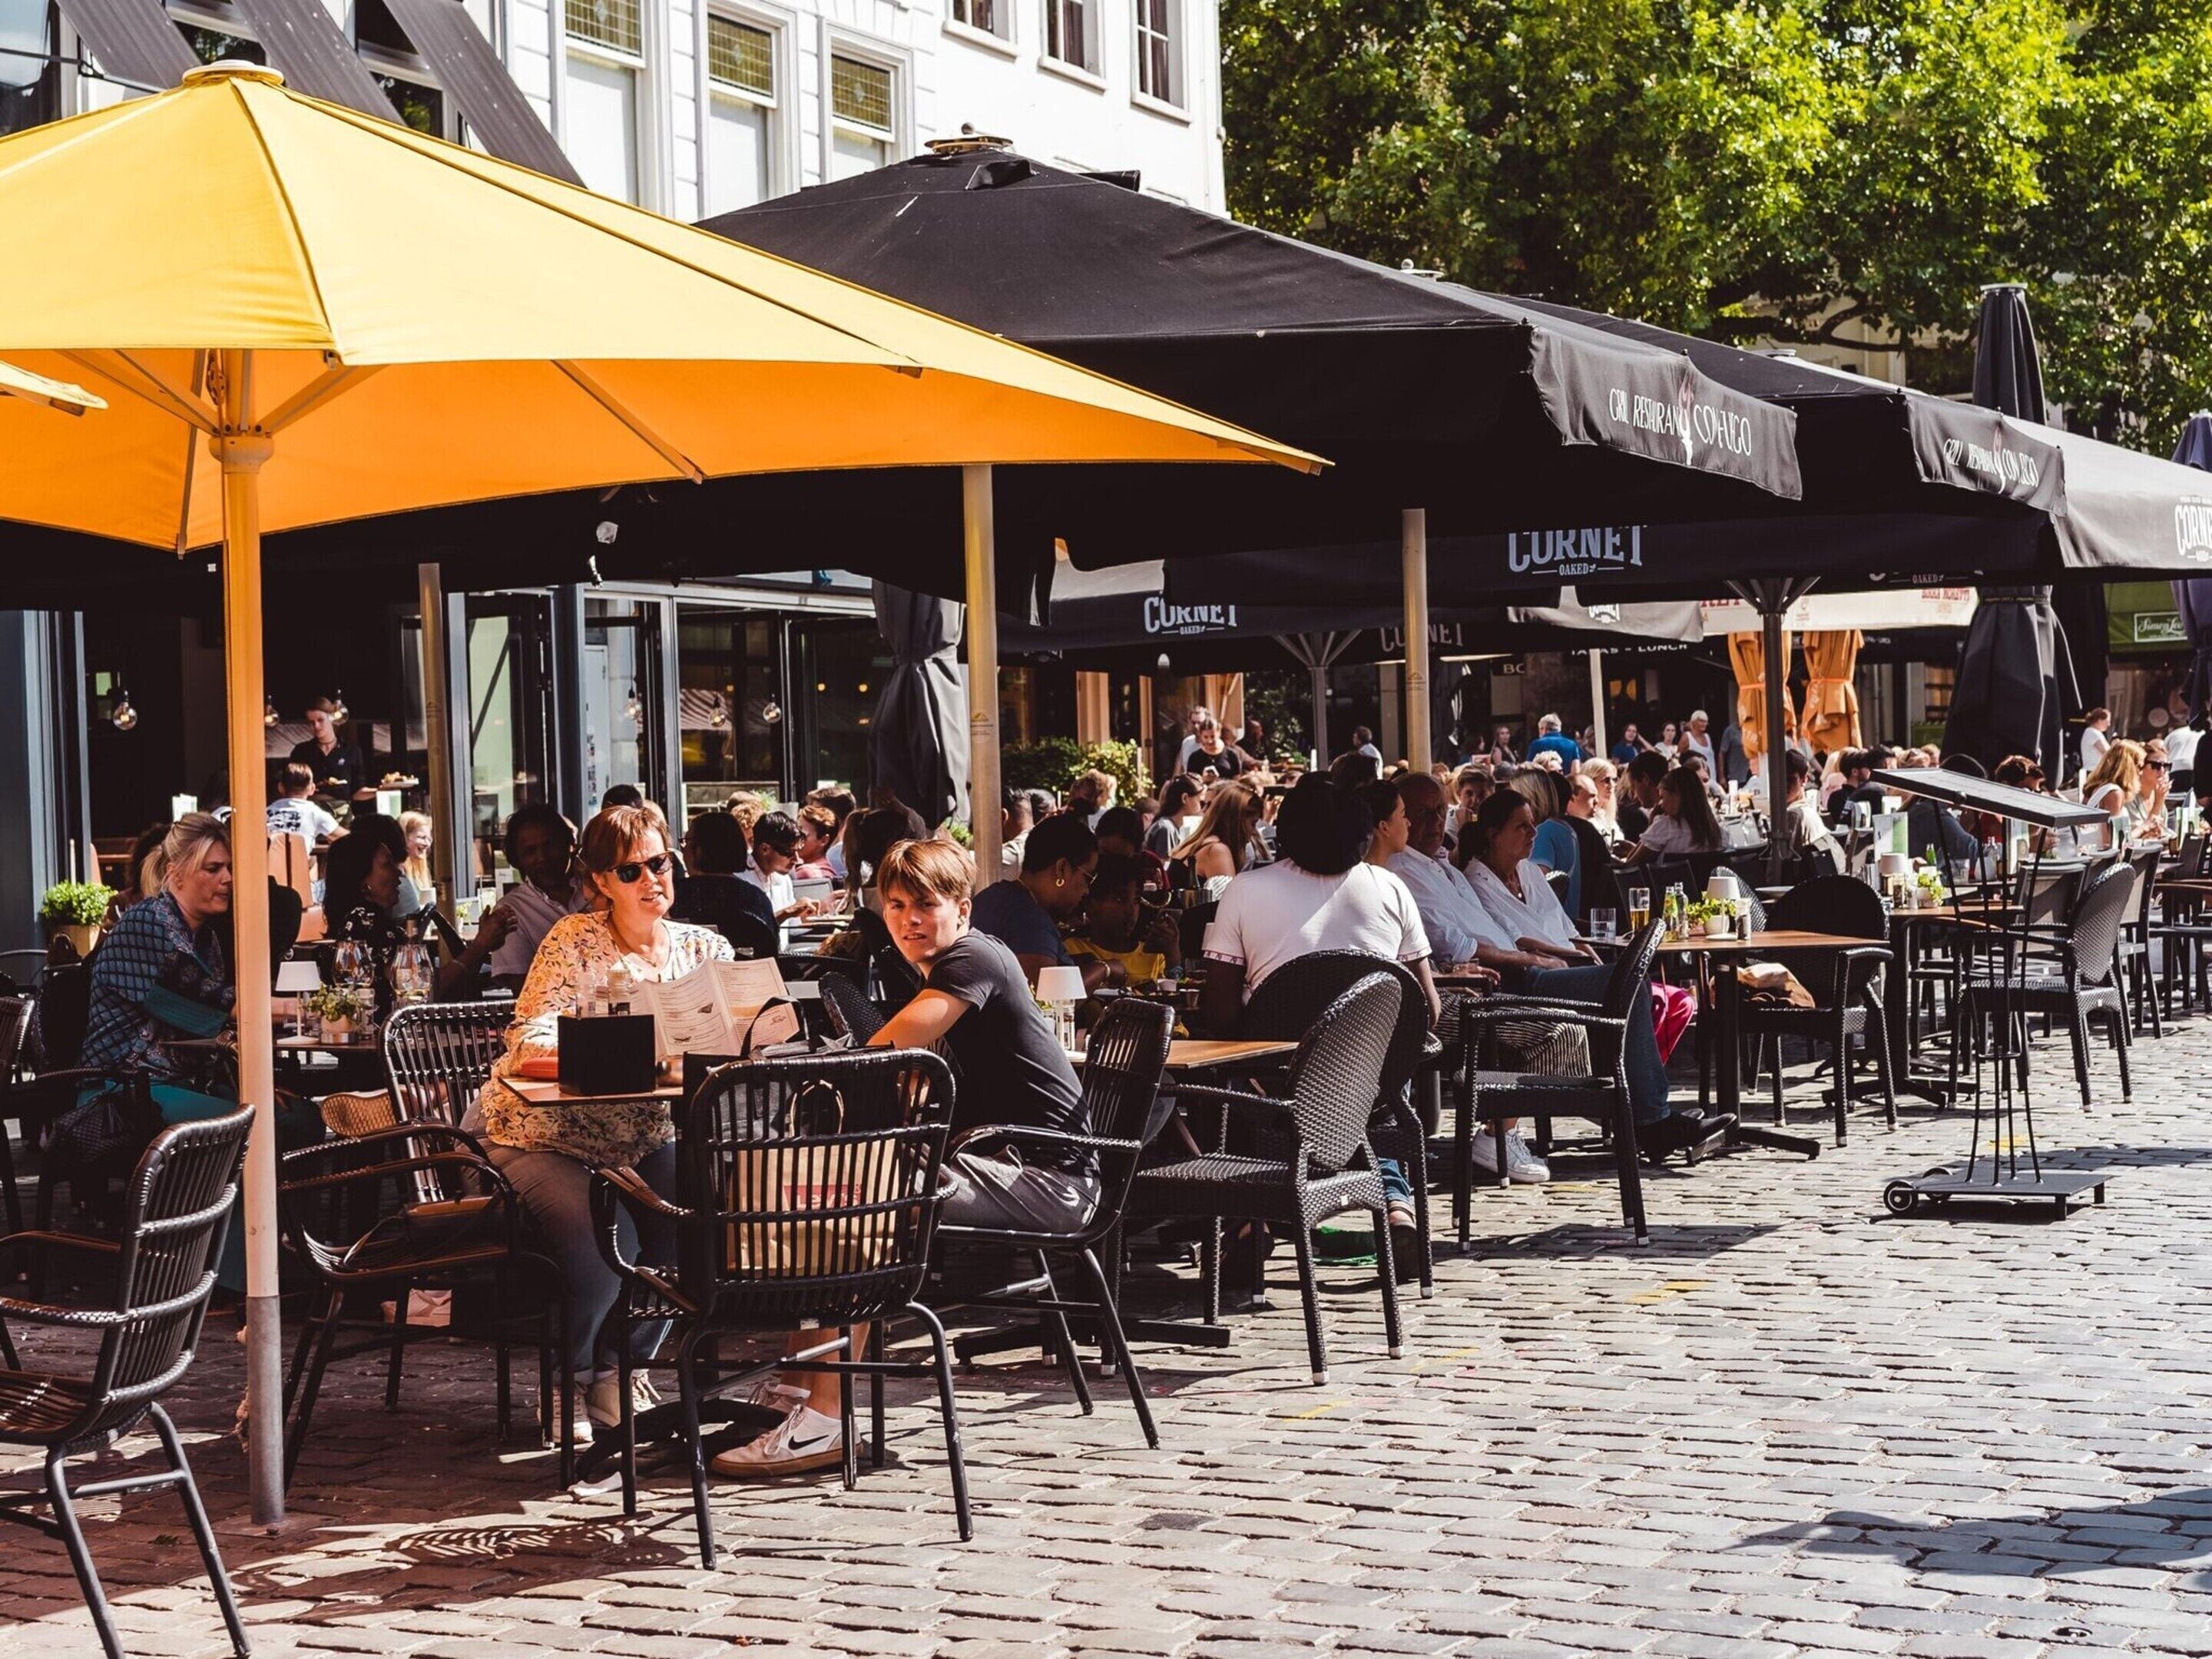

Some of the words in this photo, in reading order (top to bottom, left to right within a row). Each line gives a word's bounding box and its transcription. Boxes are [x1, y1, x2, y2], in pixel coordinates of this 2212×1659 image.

[1508, 525, 1643, 573] CORNET
[1558, 563, 1589, 576] OAKED
[1144, 596, 1237, 634] CORNET
[1380, 623, 1463, 652] CONET
